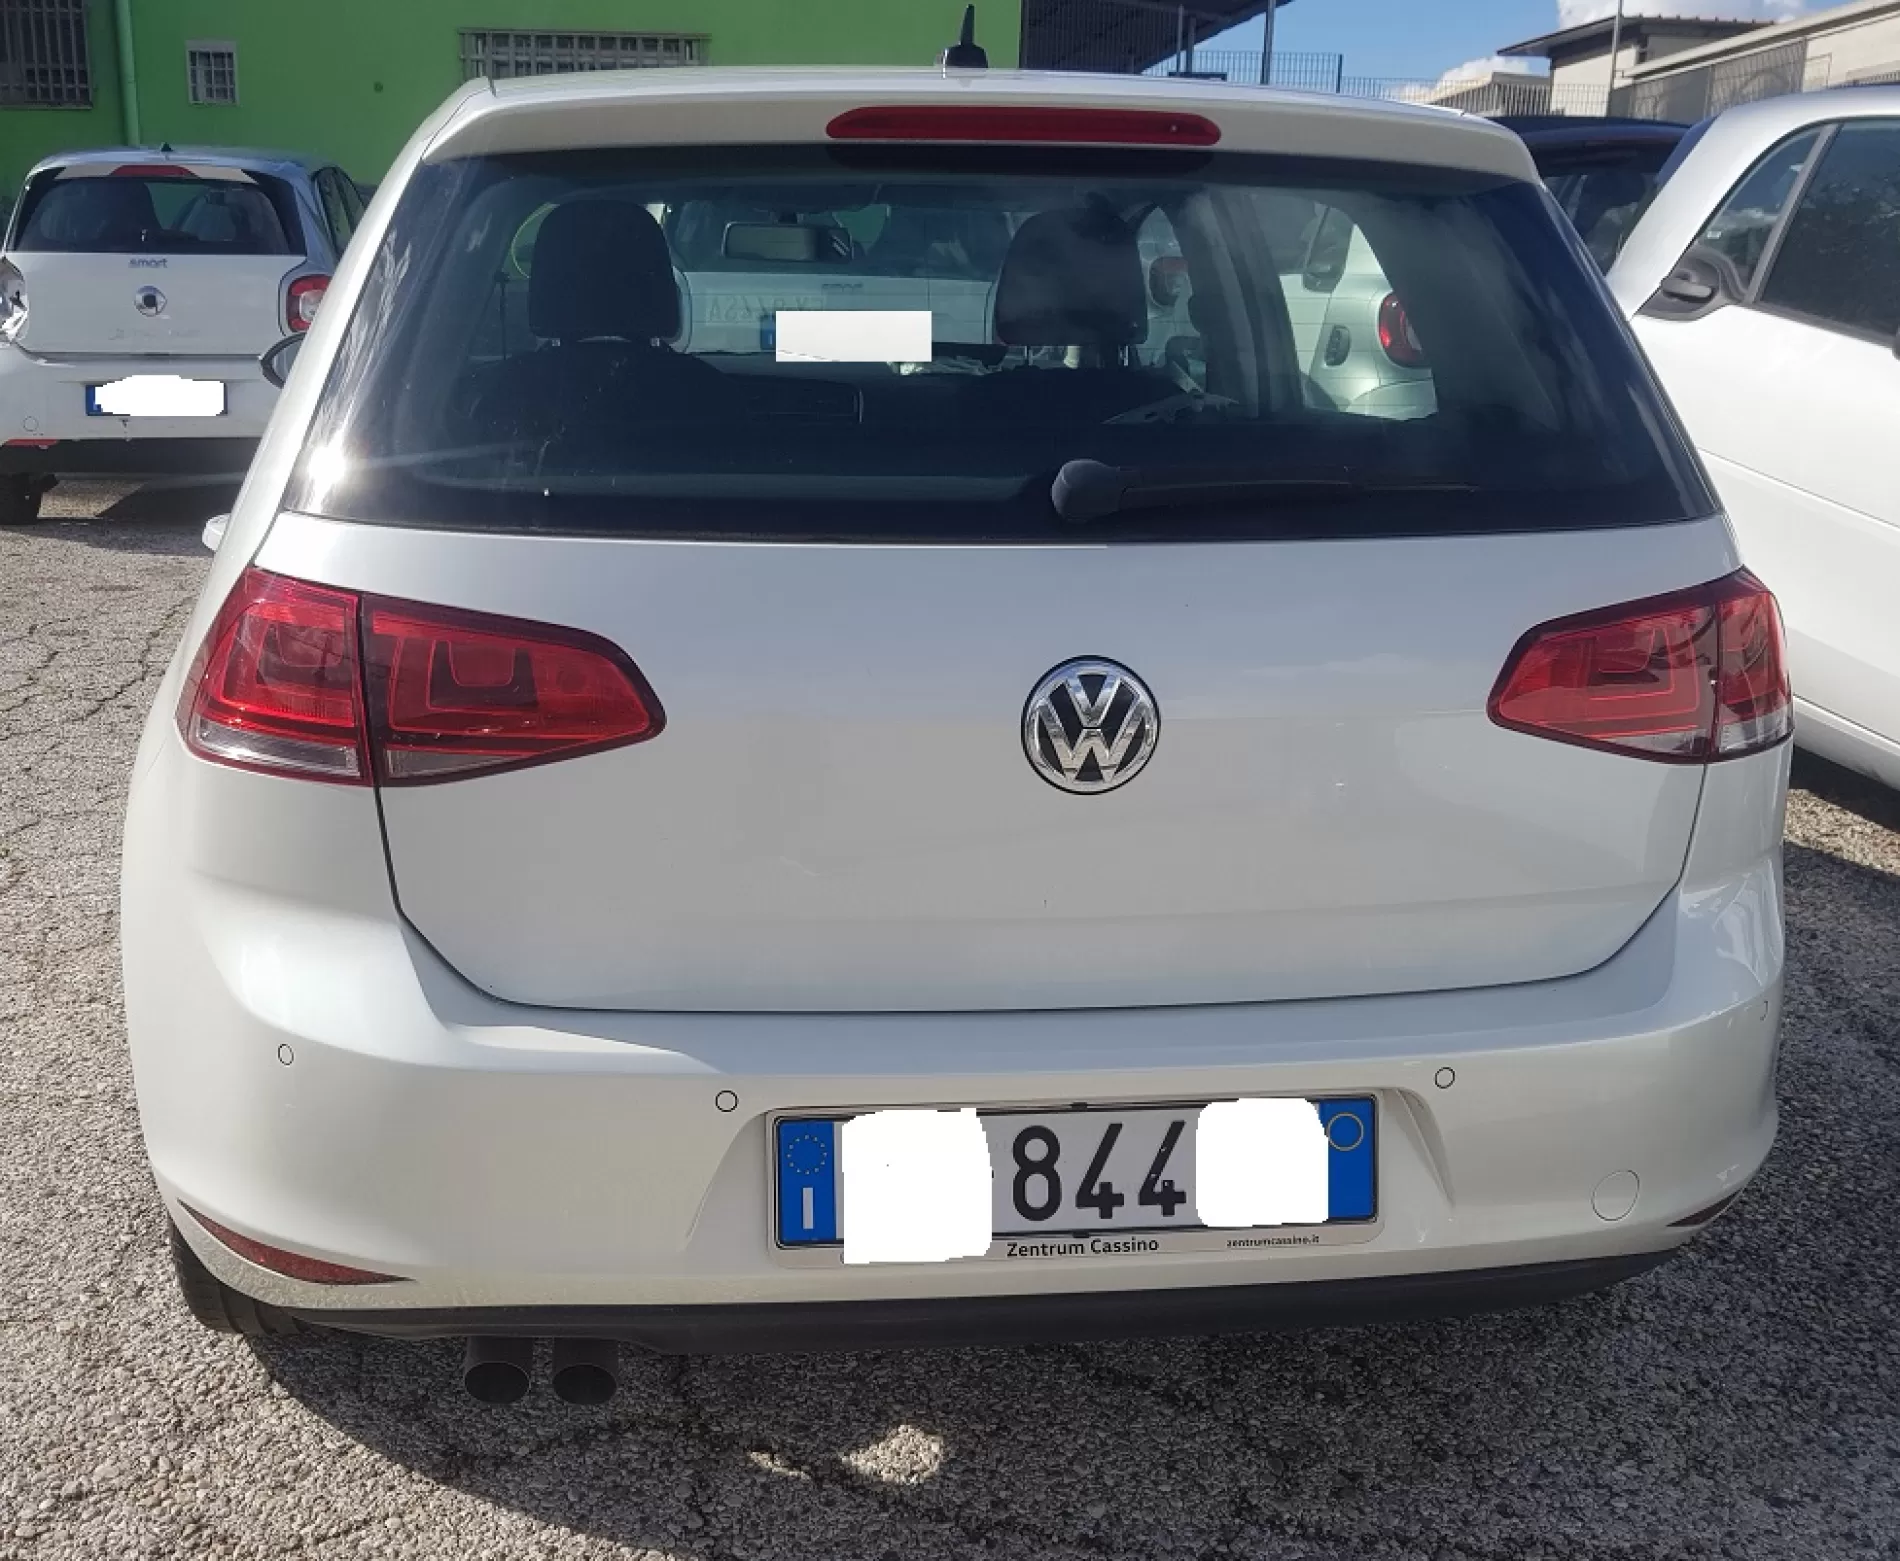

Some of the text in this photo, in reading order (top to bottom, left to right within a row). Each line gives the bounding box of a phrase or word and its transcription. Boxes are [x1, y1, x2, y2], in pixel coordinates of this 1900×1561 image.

[129, 258, 168, 268] smart
[1011, 1119, 1188, 1221] 844
[1007, 1236, 1160, 1257] Zentrum Cassino
